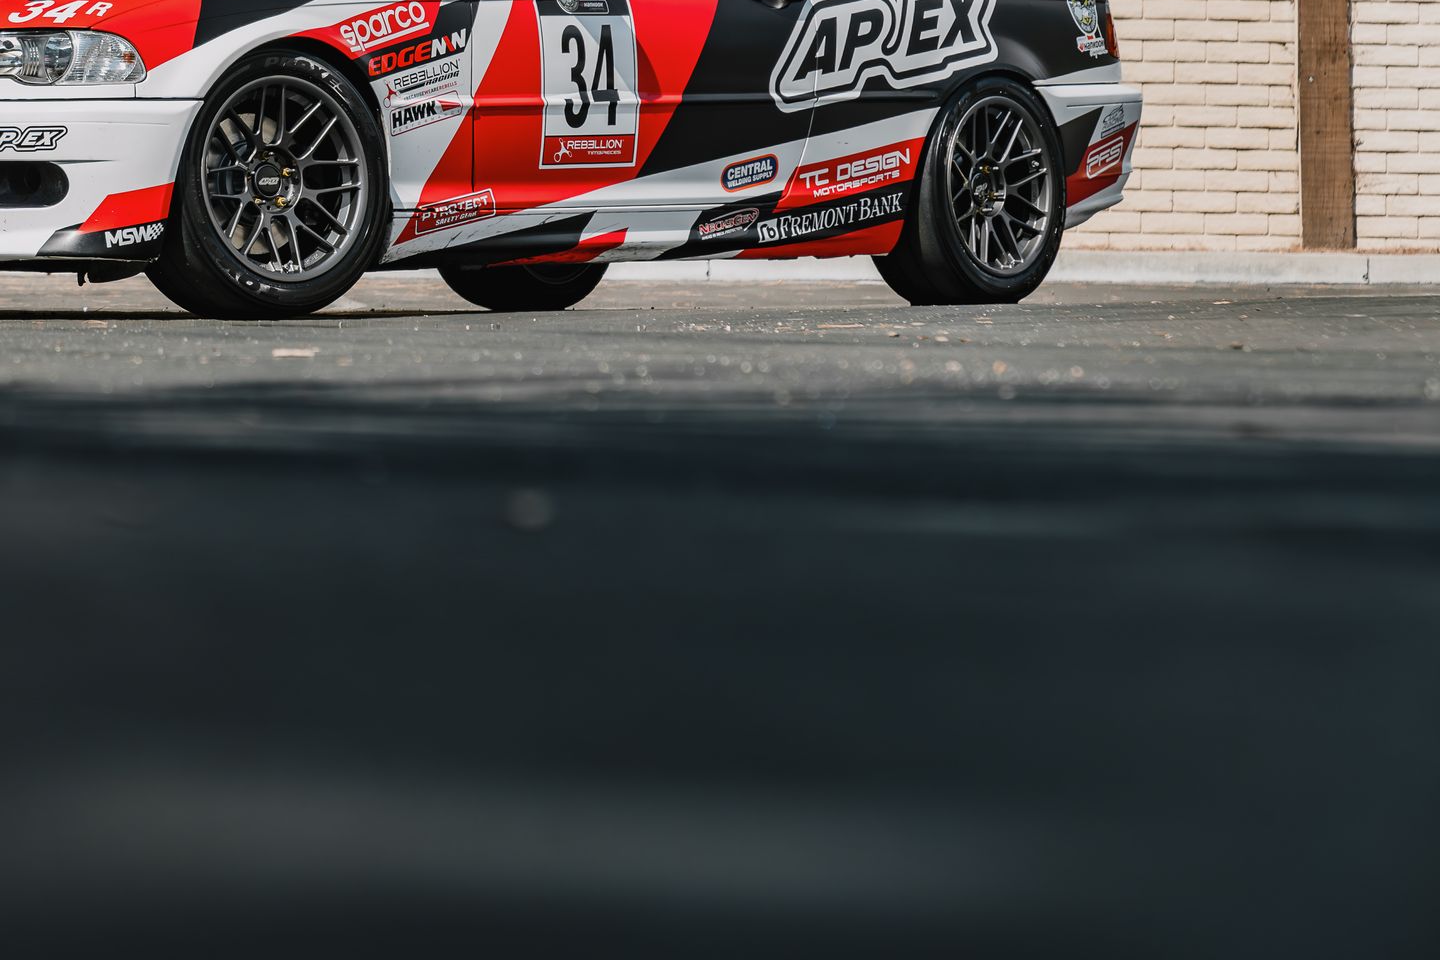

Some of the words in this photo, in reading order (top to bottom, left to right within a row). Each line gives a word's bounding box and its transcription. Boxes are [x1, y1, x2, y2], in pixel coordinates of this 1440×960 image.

[8, 0, 88, 24] 34
[85, 1, 113, 17] R
[340, 1, 428, 52] sparco
[394, 59, 459, 89] REBELLION
[562, 25, 620, 128] 34
[392, 100, 437, 129] HAWK
[567, 139, 623, 149] REBELLION
[727, 159, 773, 180] CENTRAL
[727, 176, 752, 188] WELDING
[752, 171, 773, 182] SUPPLY
[800, 168, 829, 189] TC
[837, 148, 910, 181] DESIGN
[813, 169, 900, 198] MOTORSPORTS
[422, 195, 489, 222] PYROTECT
[780, 203, 858, 240] FREMONT
[858, 192, 903, 221] BANK
[105, 225, 152, 248] MSW
